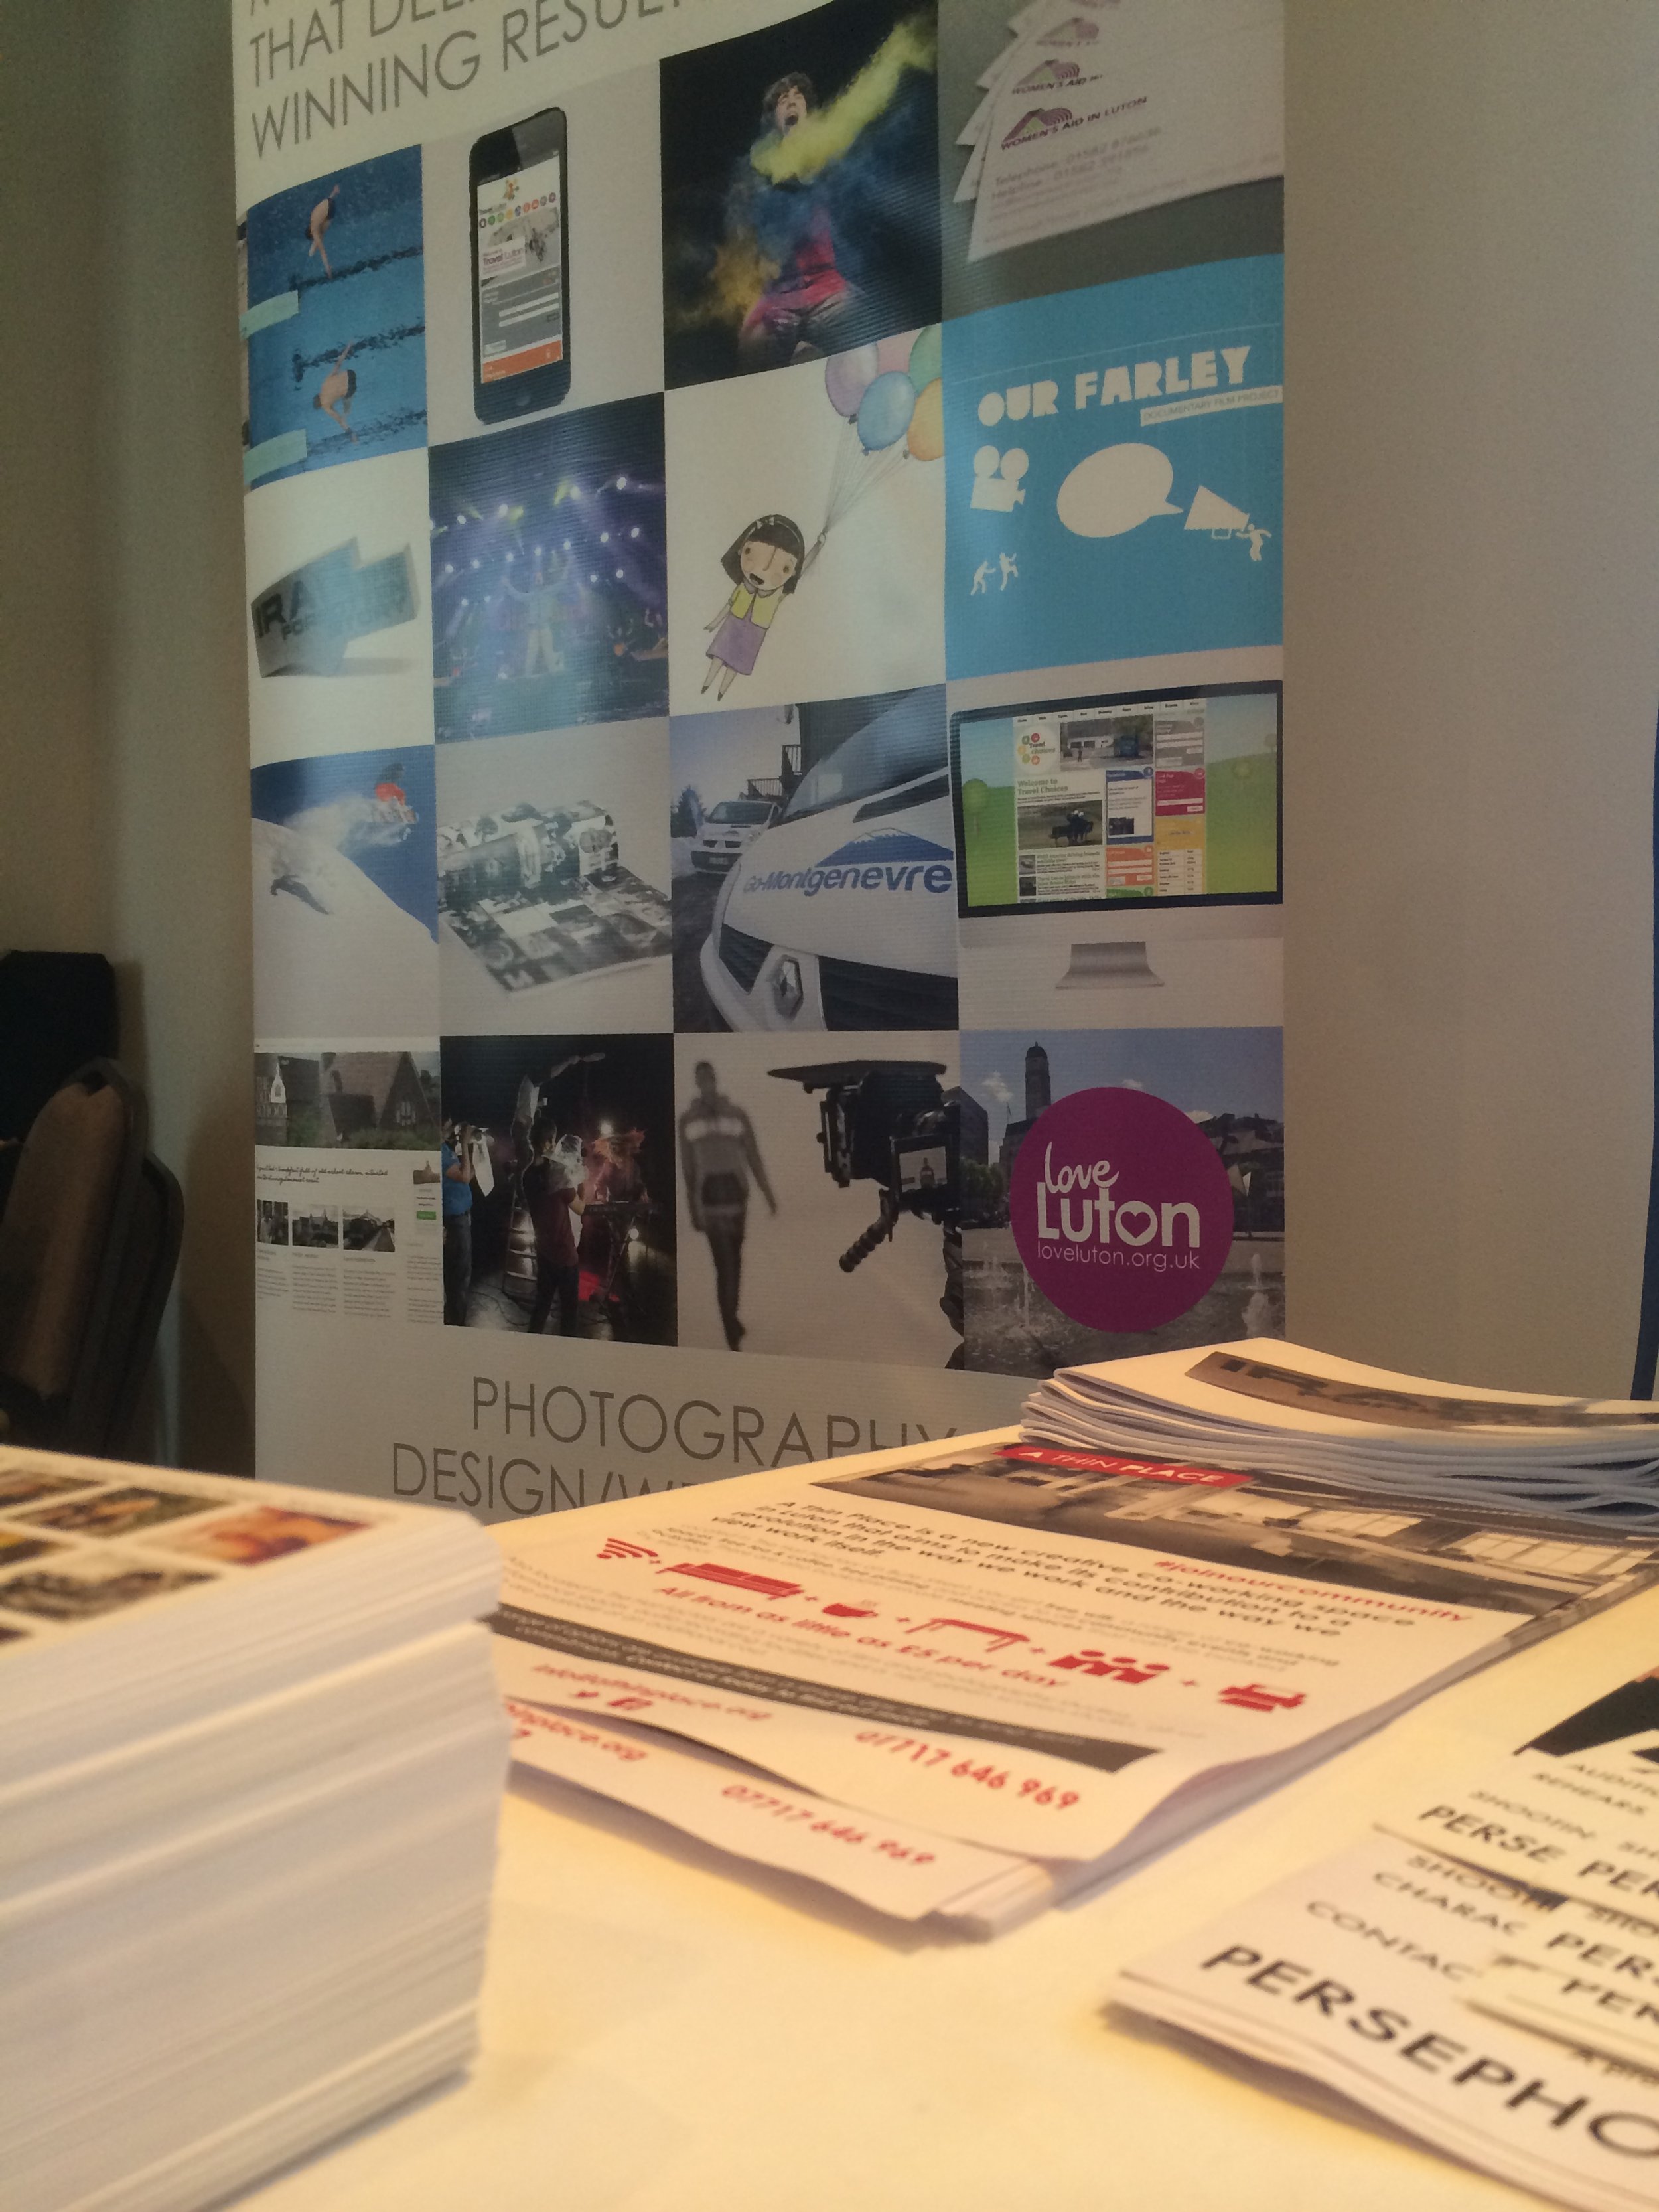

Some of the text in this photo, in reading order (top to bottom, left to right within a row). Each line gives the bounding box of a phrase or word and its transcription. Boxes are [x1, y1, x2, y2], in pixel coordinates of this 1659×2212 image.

[249, 0, 344, 87] THAT
[251, 0, 680, 159] WINNING RESU
[1001, 96, 1147, 151] WOMEN'S AID IN LUTON
[977, 345, 1252, 427] OUR FARLEY
[1143, 390, 1280, 421] DOCUMENTARY FILM PROJECT
[1017, 779, 1051, 788] Welcome
[1017, 785, 1069, 796] Travel Choices
[1044, 1141, 1119, 1194] love
[1037, 1181, 1200, 1248] Luton
[1037, 1240, 1200, 1272] loveluton.org.uk
[1052, 1454, 1117, 1469] THIN
[1119, 1463, 1224, 1483] PLACE
[765, 1526, 819, 1544] work
[778, 1510, 839, 1526] Luton
[843, 1522, 893, 1536] that
[893, 1534, 950, 1550] aims
[986, 1553, 1062, 1571] make
[1067, 1567, 1097, 1579] its
[1104, 1576, 1279, 1614] contribution
[732, 1511, 842, 1537] revolution
[872, 1538, 912, 1552] the
[918, 1549, 964, 1564] way
[977, 1562, 1016, 1573] we
[1023, 1570, 1084, 1589] work
[1094, 1586, 1156, 1603] and
[1159, 1597, 1208, 1613] the
[1218, 1609, 1275, 1627] way
[1293, 1623, 1341, 1637] we
[847, 1512, 912, 1530] Place
[961, 1538, 1012, 1552] new
[1020, 1550, 1129, 1574] creative
[1313, 1604, 1415, 1627] space
[1154, 1559, 1467, 1623] #joinourcommunity
[755, 1611, 789, 1624] as
[792, 1619, 851, 1639] little
[855, 1636, 891, 1649] as
[934, 1655, 993, 1672] per
[1001, 1669, 1064, 1688] day
[855, 1730, 952, 1768] 07717
[950, 1759, 1011, 1790] 646
[1017, 1778, 1081, 1812] 969
[810, 1818, 869, 1846] 646
[873, 1838, 937, 1866] 969
[1417, 1803, 1568, 1864] PERSE
[1372, 1872, 1529, 1937] CHARAC
[1546, 1931, 1659, 1984] PER
[1200, 1943, 1659, 2158] PERSEPHO
